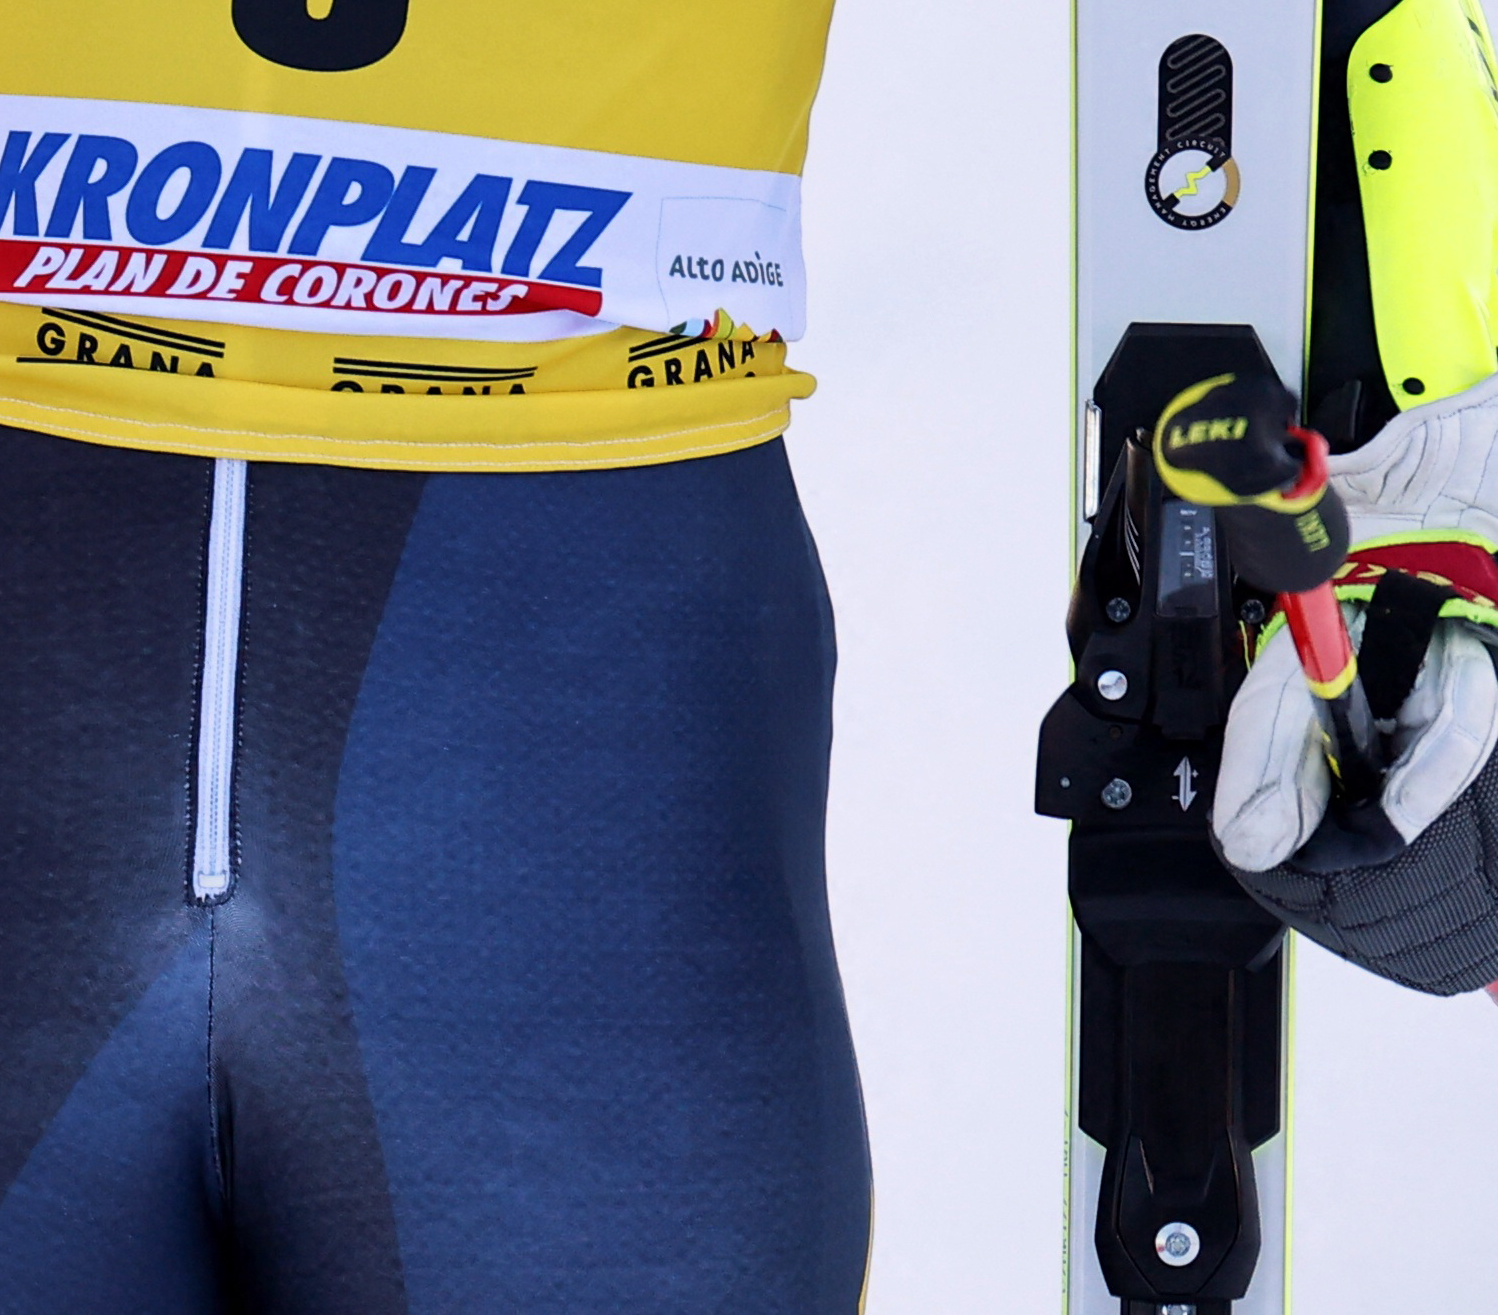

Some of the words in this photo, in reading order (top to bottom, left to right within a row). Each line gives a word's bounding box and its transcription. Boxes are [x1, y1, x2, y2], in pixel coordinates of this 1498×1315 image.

[1176, 139, 1226, 158] CIRCUIT
[13, 245, 168, 294] PLAN
[166, 254, 247, 302] DE
[262, 260, 529, 313] CORONES
[627, 338, 757, 391] GRANA
[1168, 416, 1249, 450] LEKI
